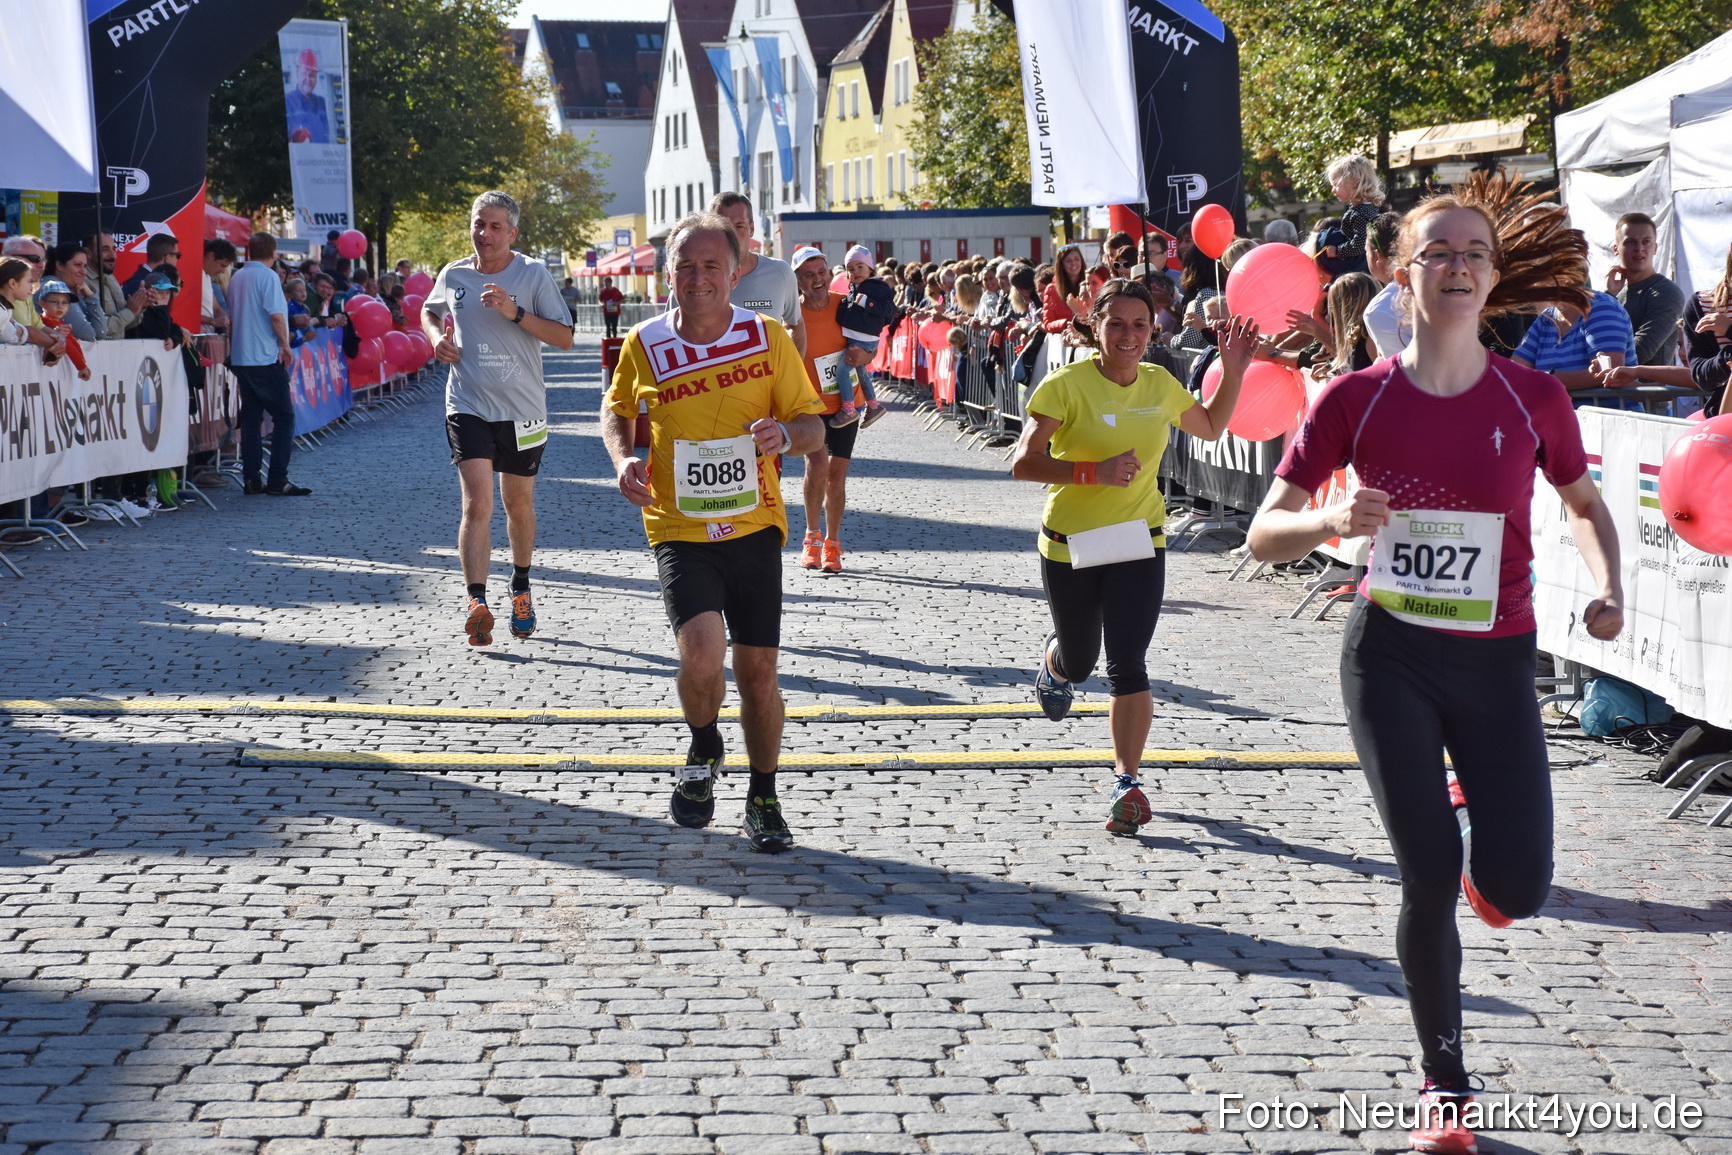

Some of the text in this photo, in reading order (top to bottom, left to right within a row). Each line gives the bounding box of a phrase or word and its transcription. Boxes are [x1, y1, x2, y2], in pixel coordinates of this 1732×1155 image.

[107, 0, 190, 48] PARTL
[477, 343, 493, 353] 19.
[657, 378, 711, 406] MAX
[716, 361, 773, 389] BÖGL
[698, 446, 736, 456] BOCK
[687, 458, 747, 486] 5088
[700, 499, 738, 510] Johann
[1410, 521, 1464, 535] BOCK
[1391, 543, 1481, 581] 5027
[1396, 581, 1461, 594] PARTL Neumarkt
[1404, 598, 1457, 616] Natalie
